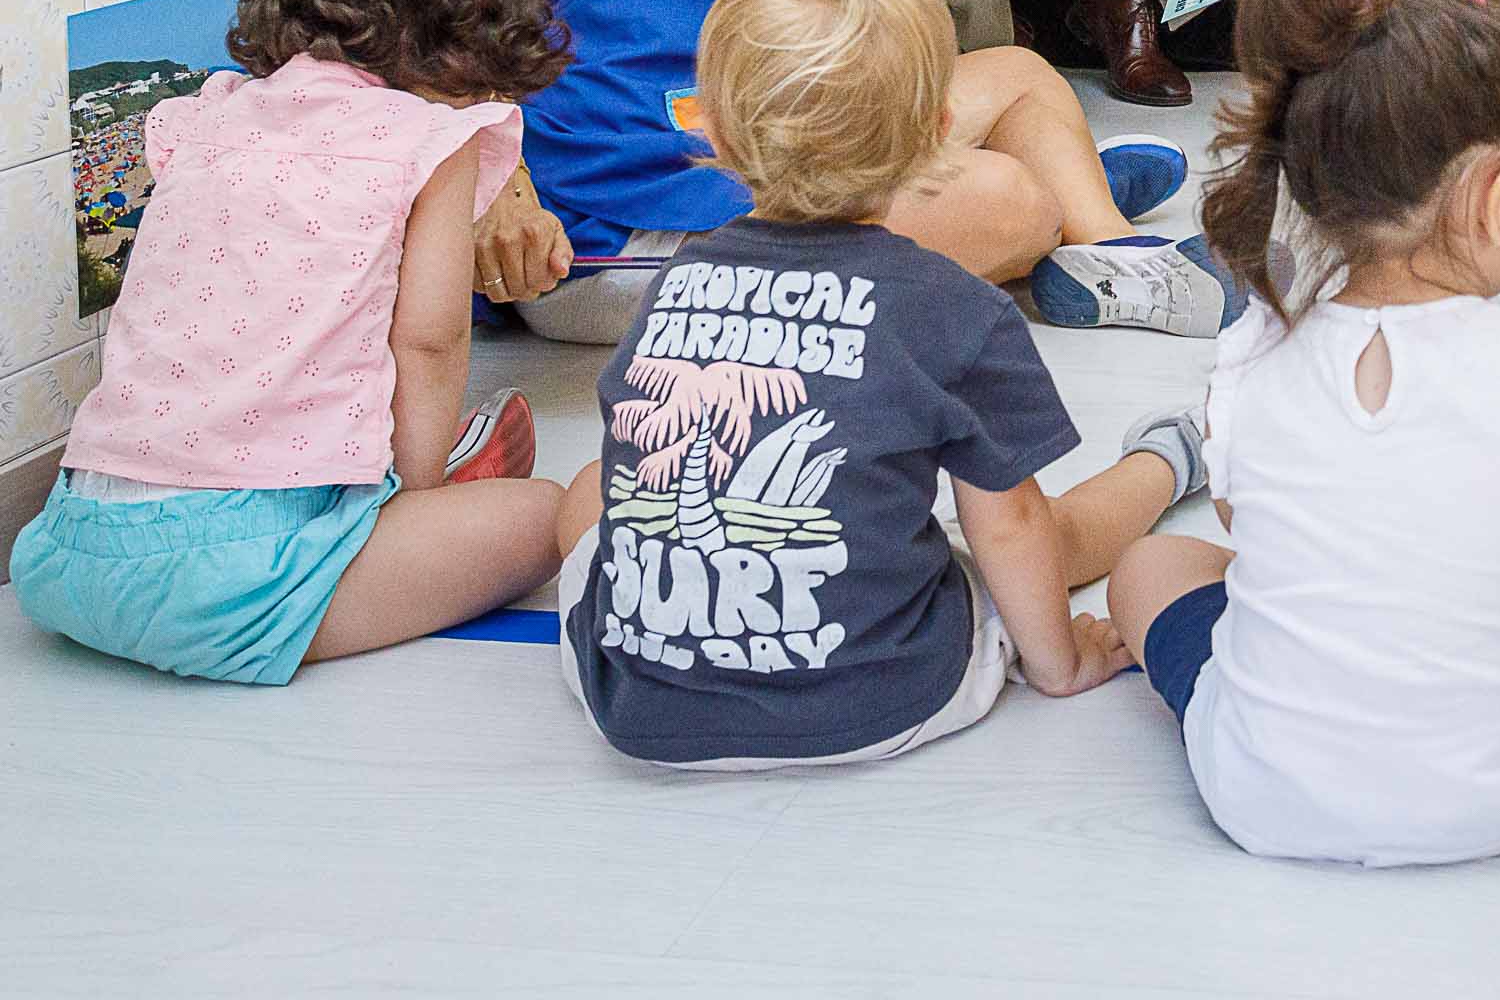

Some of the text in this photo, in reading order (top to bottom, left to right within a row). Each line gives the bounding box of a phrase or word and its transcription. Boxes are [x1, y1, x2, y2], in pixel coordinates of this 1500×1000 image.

[653, 261, 876, 326] TROPICAL
[635, 311, 866, 380] PARADISE
[602, 526, 849, 637] SURF
[700, 622, 846, 675] DAY
